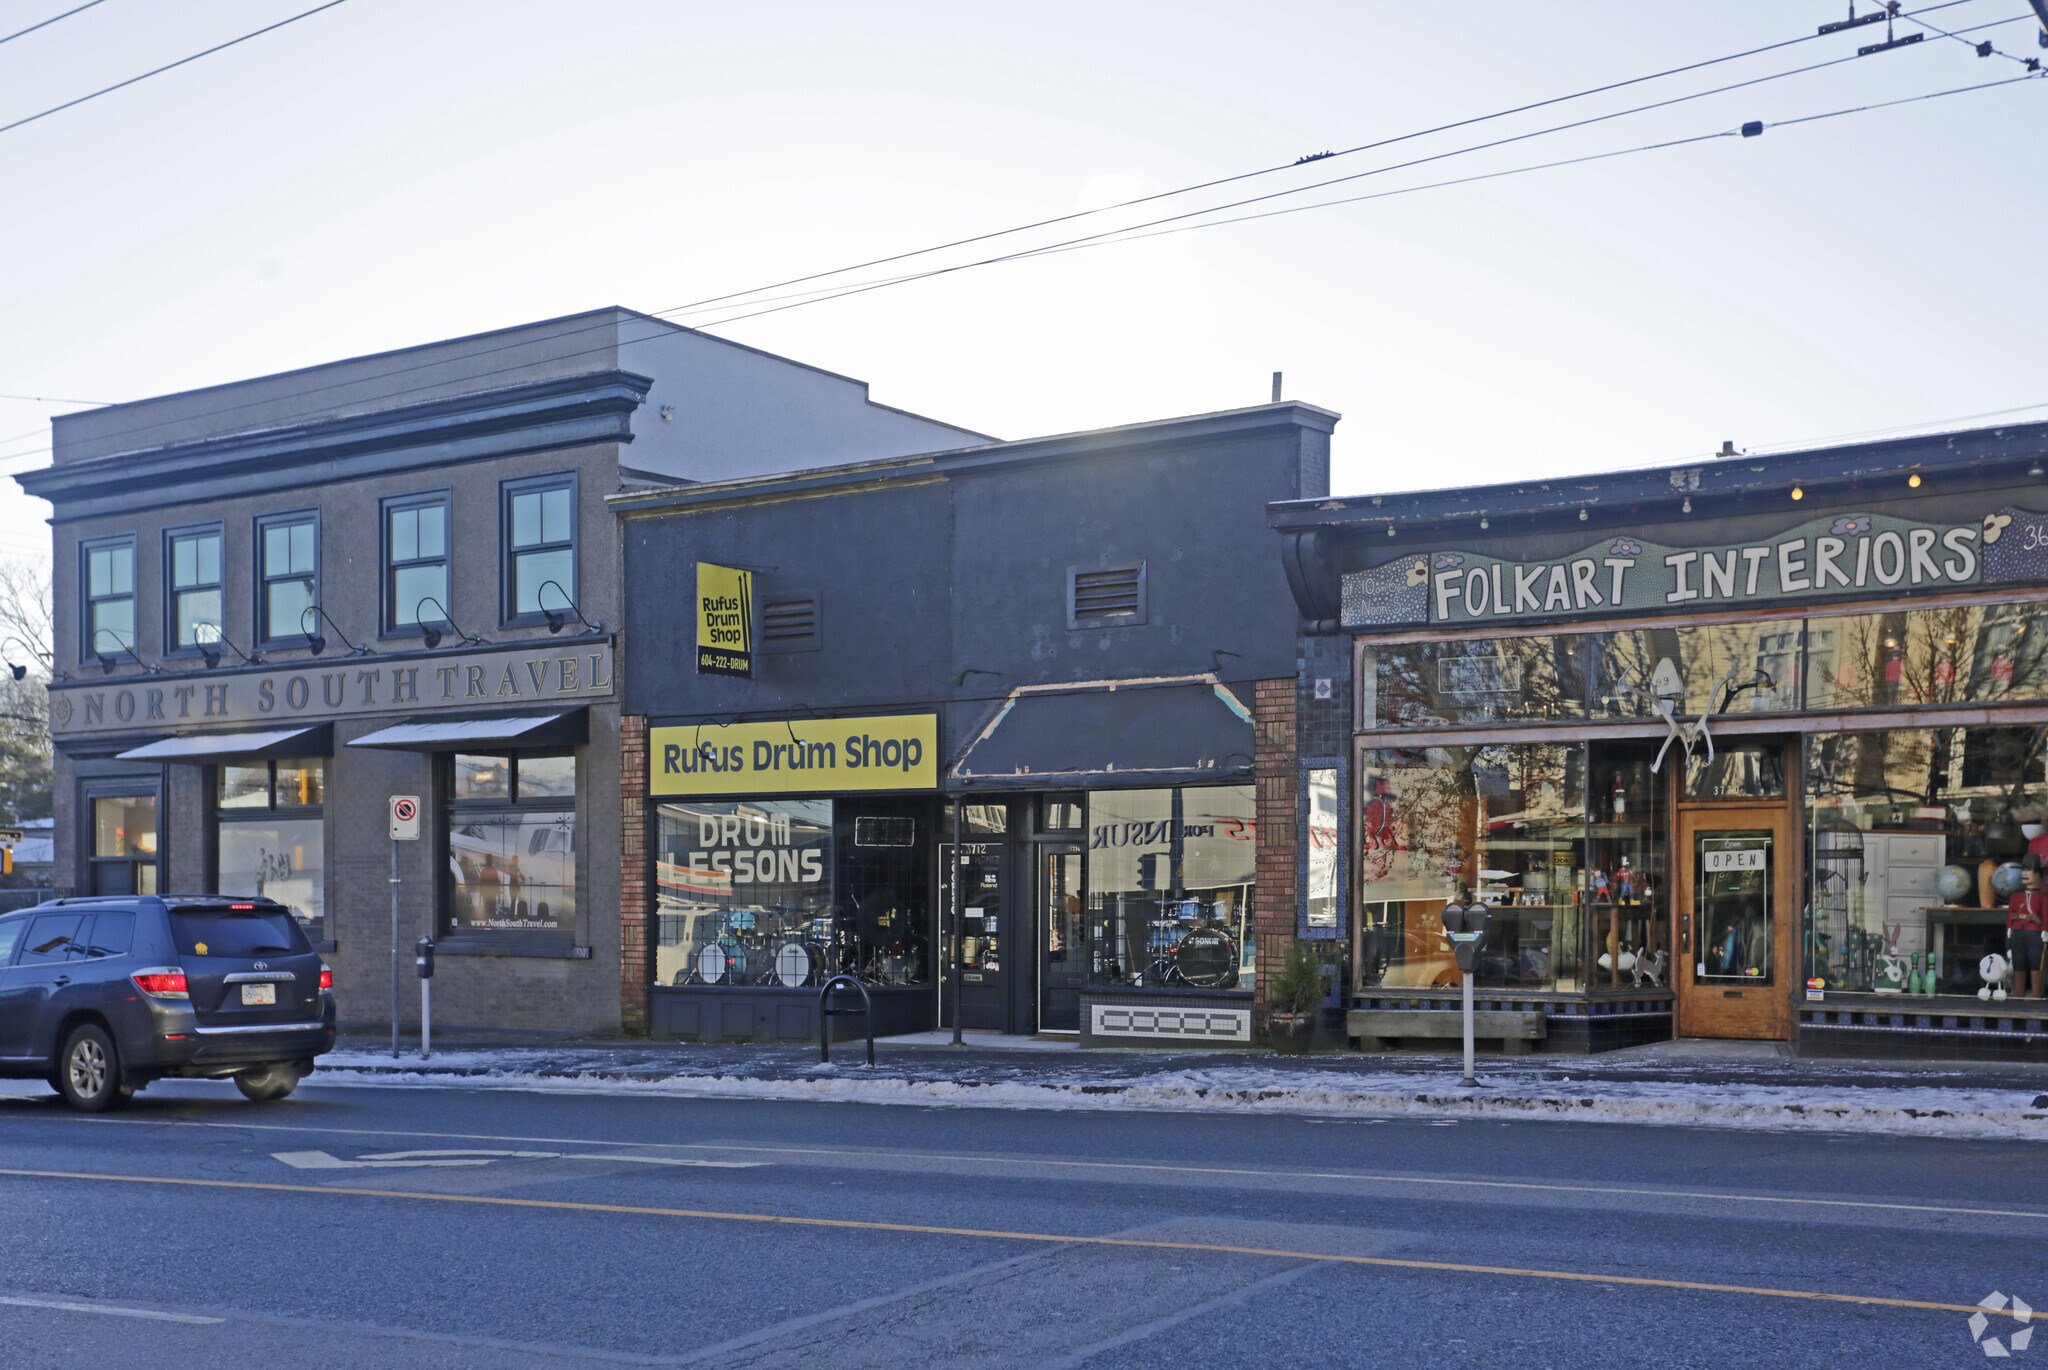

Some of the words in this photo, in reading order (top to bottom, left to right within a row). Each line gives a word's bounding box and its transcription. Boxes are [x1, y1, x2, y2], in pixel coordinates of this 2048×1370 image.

[1433, 558, 1636, 621] FOLKART
[1664, 526, 1978, 603] INTERIORS
[702, 596, 739, 612] Rufus
[706, 612, 740, 627] Drum
[710, 628, 741, 644] Shop
[701, 654, 748, 671] 604-222-DRUM
[83, 683, 229, 725] NORTH
[257, 667, 419, 714] SOUTH
[435, 653, 613, 699] TRAVEL
[664, 740, 744, 774] Rufus
[753, 739, 836, 771] Drum
[844, 734, 923, 773] Shop
[1713, 786, 1740, 796] 3720
[699, 812, 791, 848] DRUM
[966, 844, 986, 854] 3712
[668, 848, 823, 885] LESSONS
[1713, 853, 1757, 867] OPEN
[471, 918, 557, 928] www.NorthSouthTravel.com
[1194, 937, 1220, 945] SONOR
